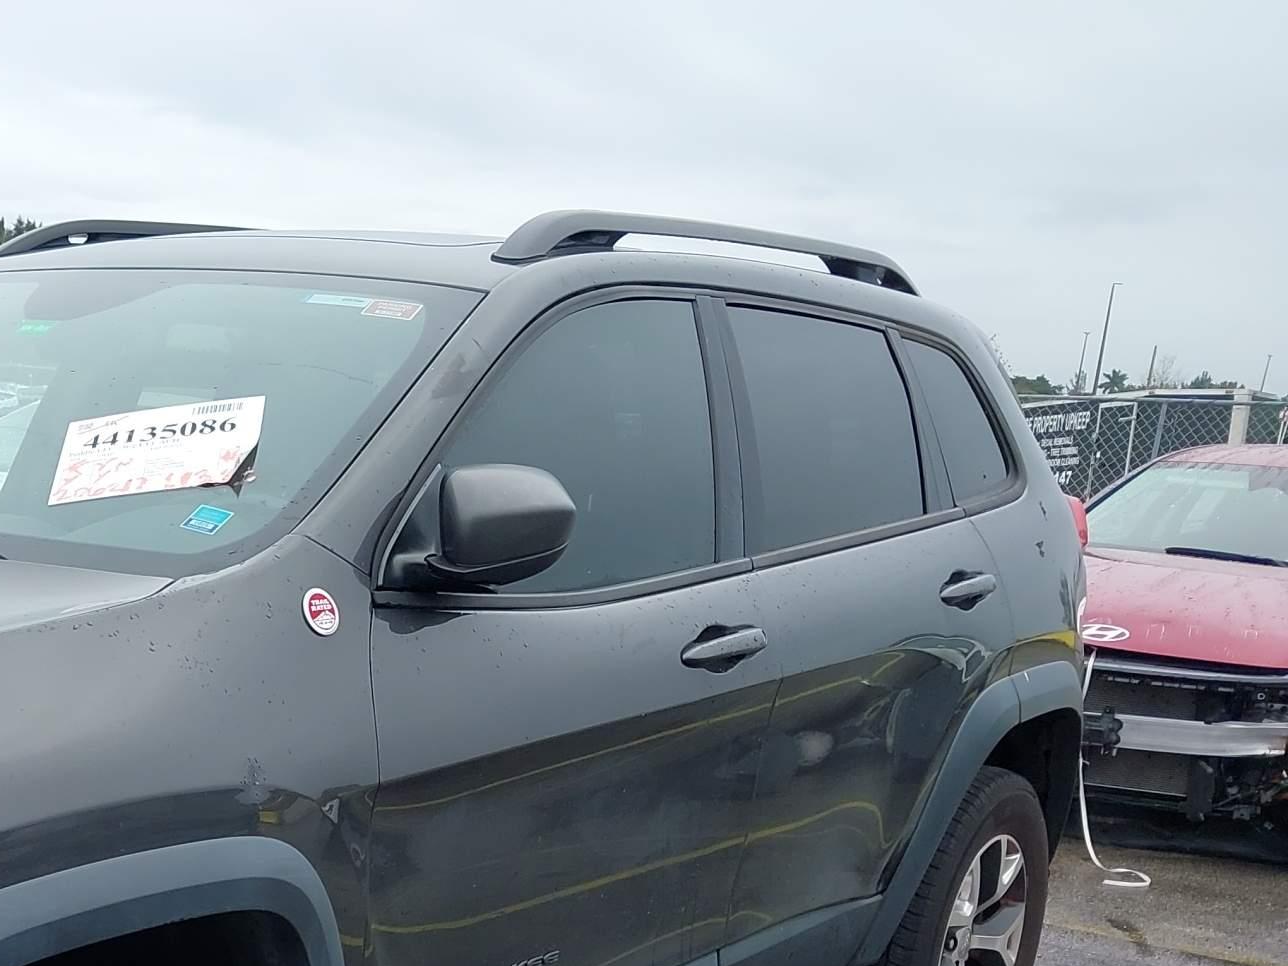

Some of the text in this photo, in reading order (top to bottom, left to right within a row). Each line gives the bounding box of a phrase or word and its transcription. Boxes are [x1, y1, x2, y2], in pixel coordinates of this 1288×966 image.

[83, 417, 237, 449] 44135086
[1032, 414, 1065, 432] PROPERTY
[1064, 411, 1090, 430] UPKEEP
